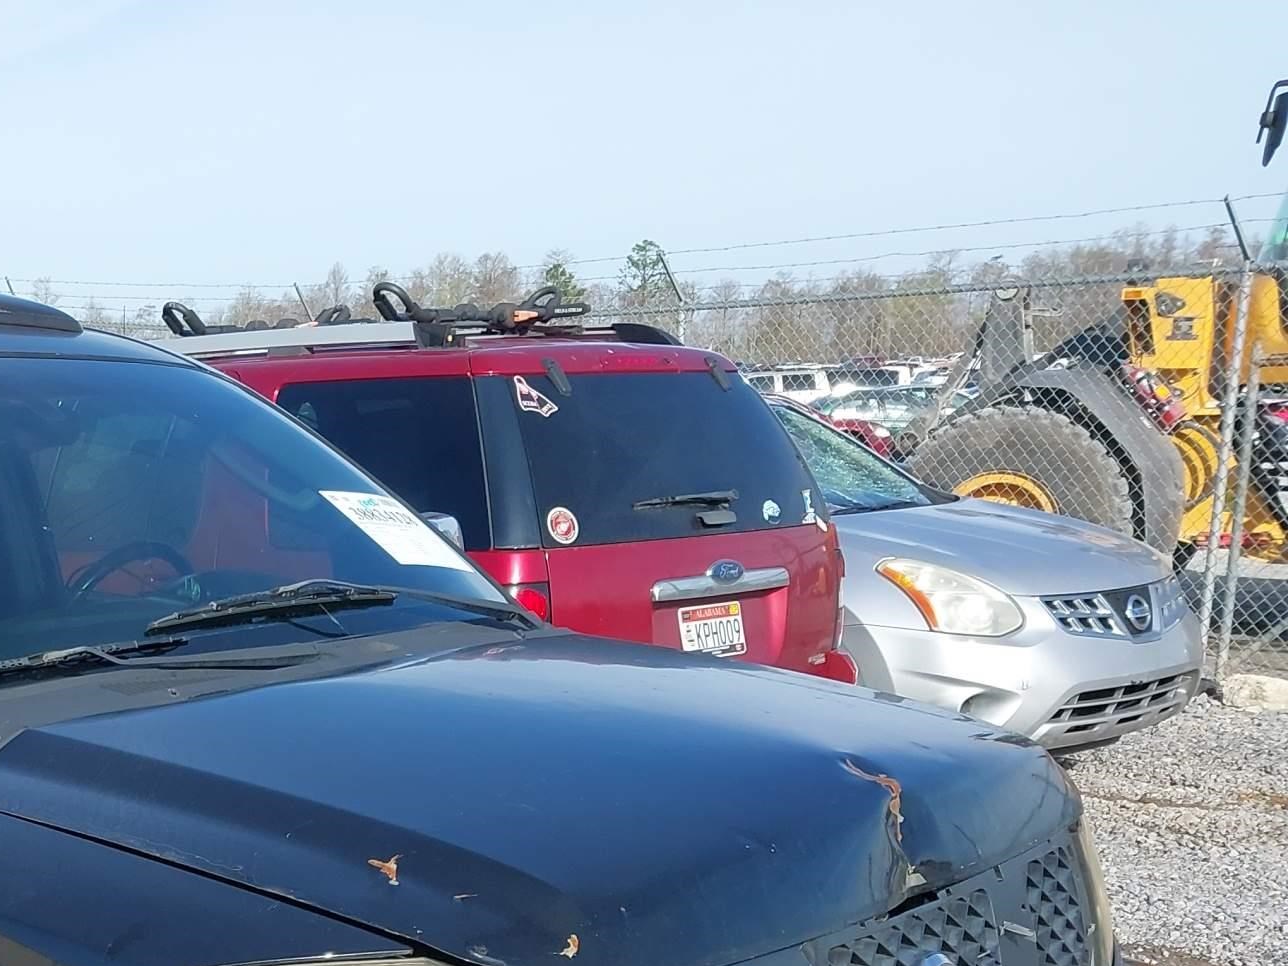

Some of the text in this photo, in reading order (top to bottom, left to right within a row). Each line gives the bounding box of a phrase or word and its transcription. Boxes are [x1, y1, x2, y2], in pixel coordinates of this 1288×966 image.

[719, 563, 740, 579] Ford
[695, 605, 727, 618] ALABAMA
[694, 618, 741, 649] KPH009
